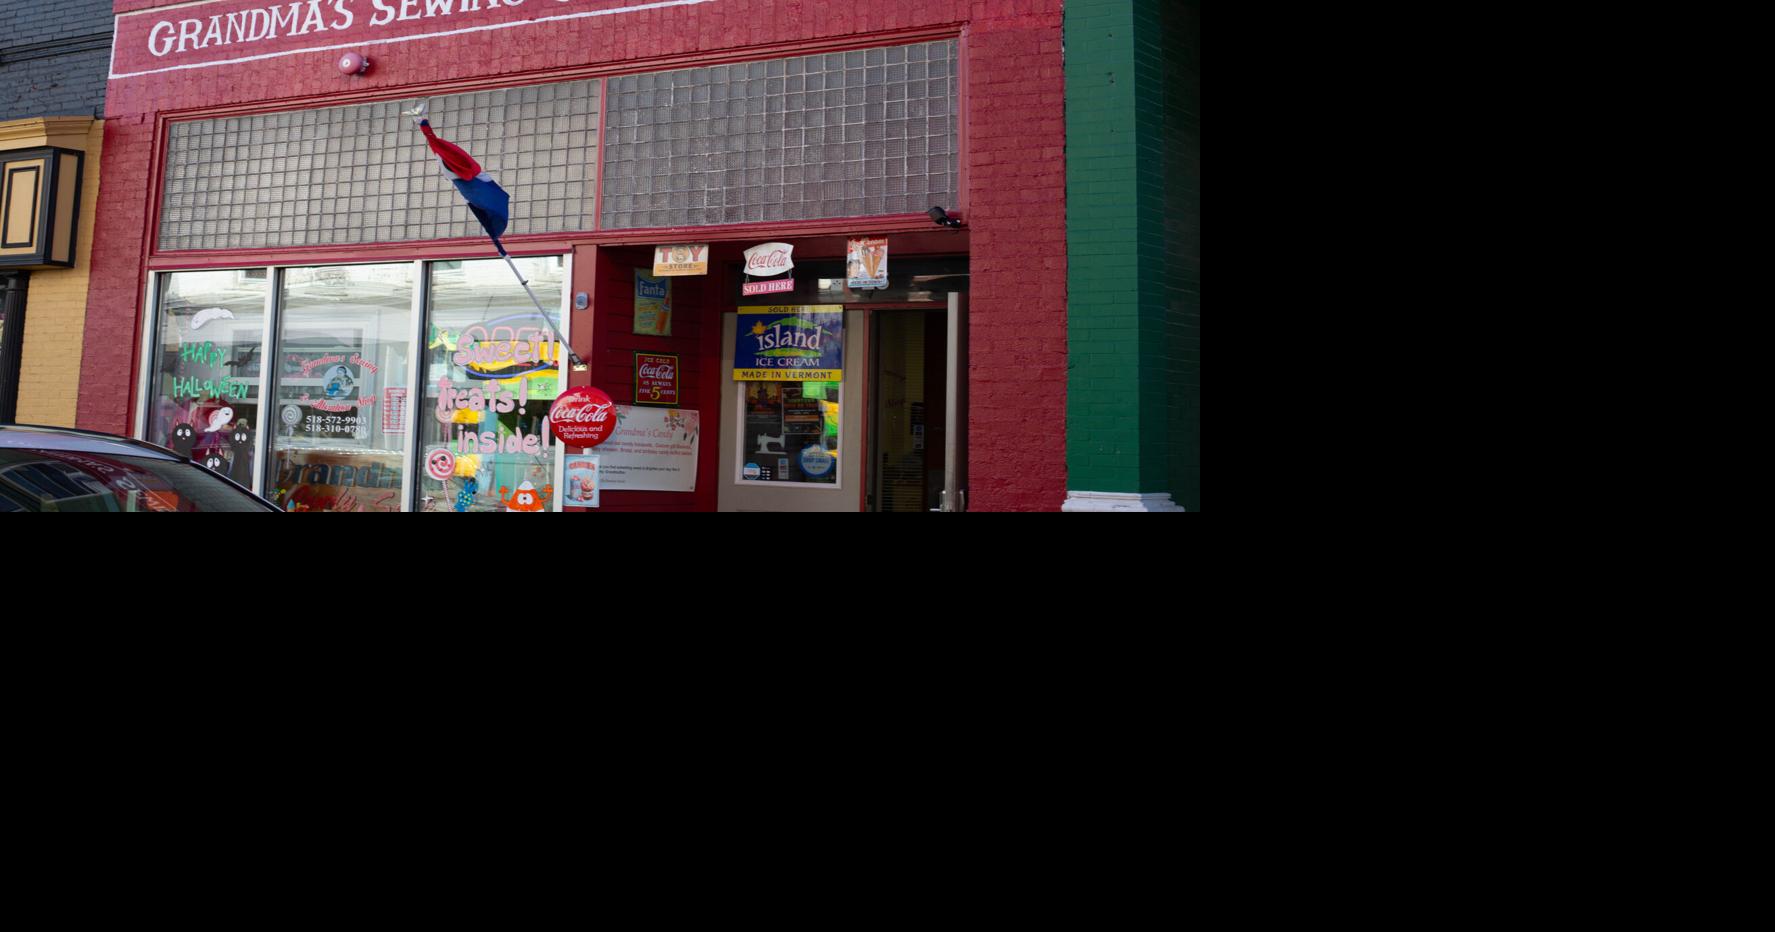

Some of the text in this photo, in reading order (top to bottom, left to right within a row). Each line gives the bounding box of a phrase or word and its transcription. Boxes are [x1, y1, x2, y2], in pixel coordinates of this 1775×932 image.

[148, 0, 354, 57] GRANDMA'S
[659, 245, 704, 263] TOY
[639, 280, 665, 296] Fanta
[743, 279, 794, 295] SOLD HERE
[756, 323, 822, 351] island
[180, 341, 227, 368] HAPPY
[755, 357, 820, 367] ICE CREAM
[785, 371, 833, 379] VERMONT
[172, 376, 249, 400] HALLOWEEN
[437, 376, 528, 415] treats!
[650, 386, 661, 400] 5
[305, 415, 367, 424] 518-572-9903
[549, 401, 613, 424] Coca-Cola
[457, 415, 550, 458] inside!
[558, 425, 588, 433] Delicious
[562, 432, 599, 440] Refreshing
